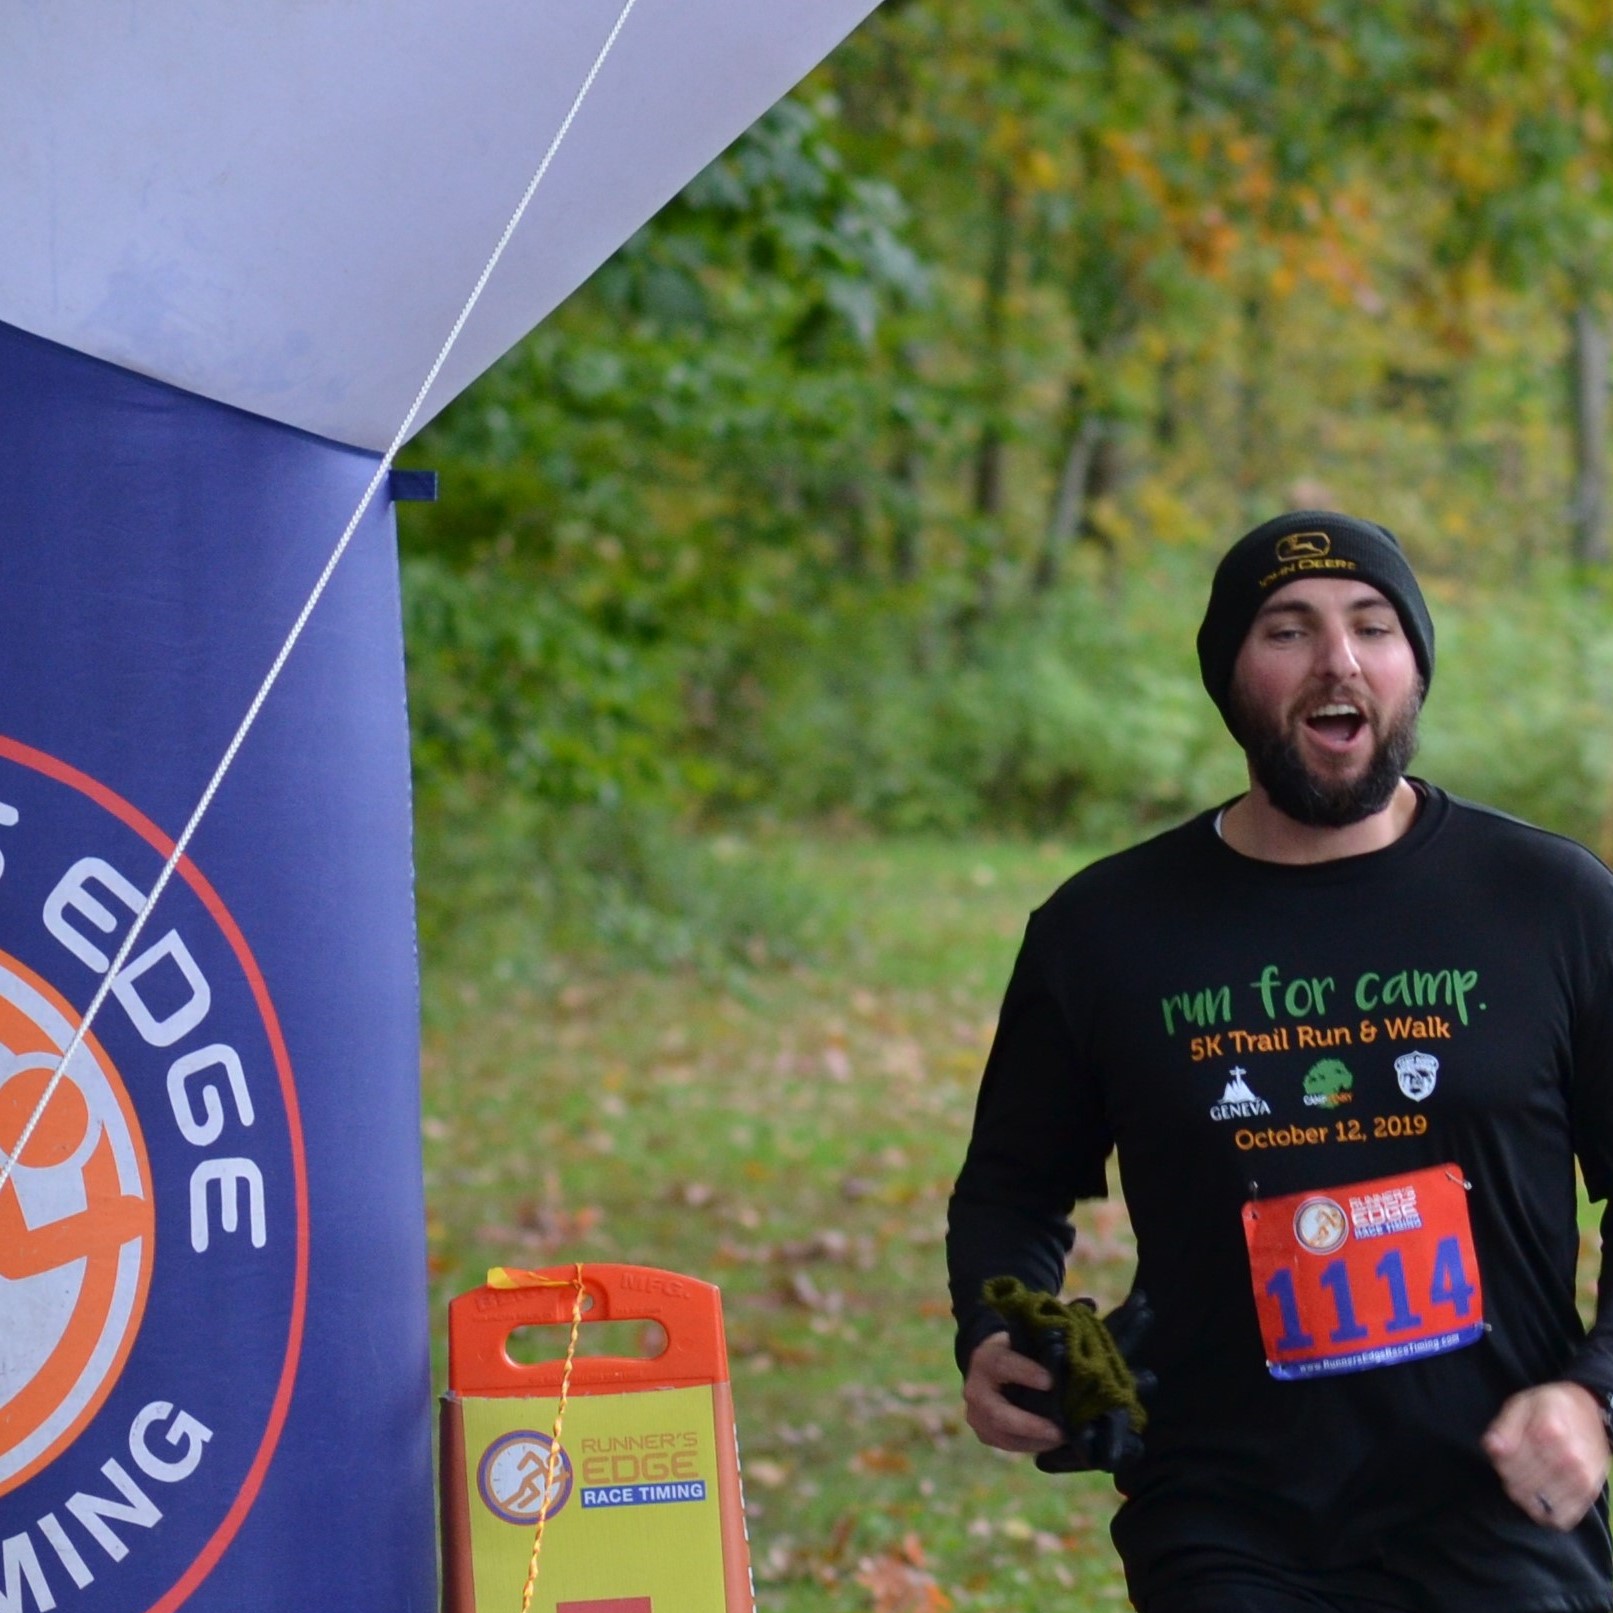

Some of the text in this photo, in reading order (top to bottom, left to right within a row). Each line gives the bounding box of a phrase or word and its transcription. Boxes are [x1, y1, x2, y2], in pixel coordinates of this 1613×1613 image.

[1161, 965, 1487, 1036] run for camp.
[42, 856, 268, 1252] EDGE
[1190, 1016, 1452, 1062] 5K Trail Run & Walk
[1209, 1099, 1272, 1121] GENEVA
[1234, 1114, 1428, 1151] October 12, 2019
[1351, 1200, 1419, 1228] EDGE
[1265, 1235, 1475, 1351] 1114
[581, 1450, 699, 1485] EDGE
[583, 1482, 704, 1506] RACE TIMING
